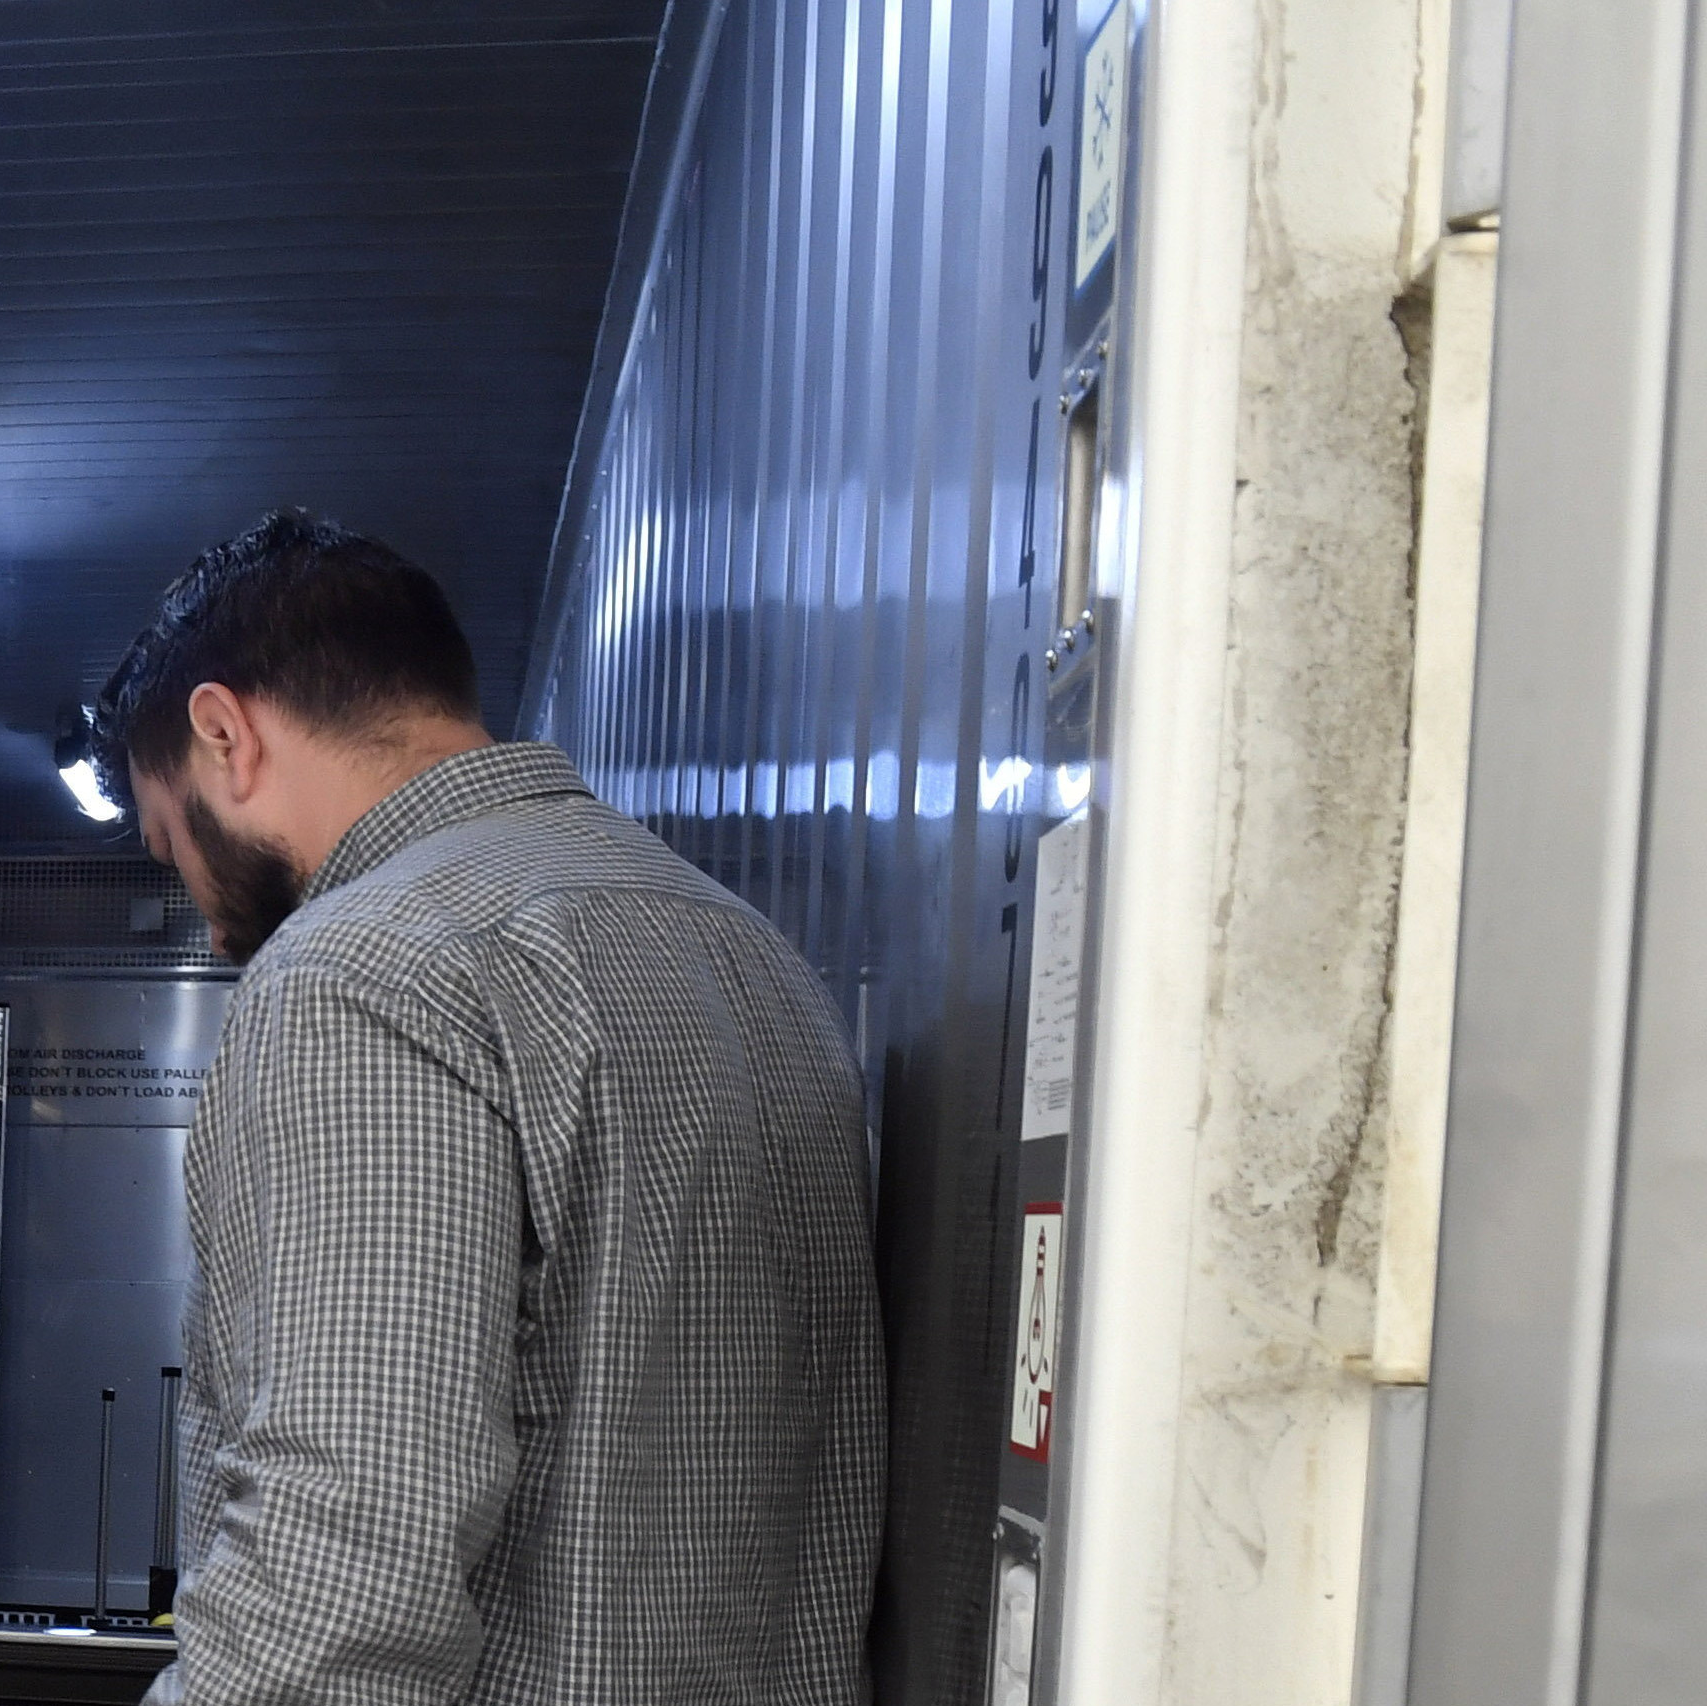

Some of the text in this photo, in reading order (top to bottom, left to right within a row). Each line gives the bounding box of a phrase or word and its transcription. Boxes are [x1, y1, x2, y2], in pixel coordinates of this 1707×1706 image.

[35, 1048, 57, 1059] AIR
[62, 1048, 146, 1060] DISCHARGE
[29, 1067, 71, 1078] DON'T
[77, 1067, 127, 1078] BLOCK
[131, 1068, 159, 1079] USE
[8, 1085, 67, 1097] OLLEYS
[86, 1085, 130, 1097] DON'T
[135, 1086, 175, 1098] LOAD
